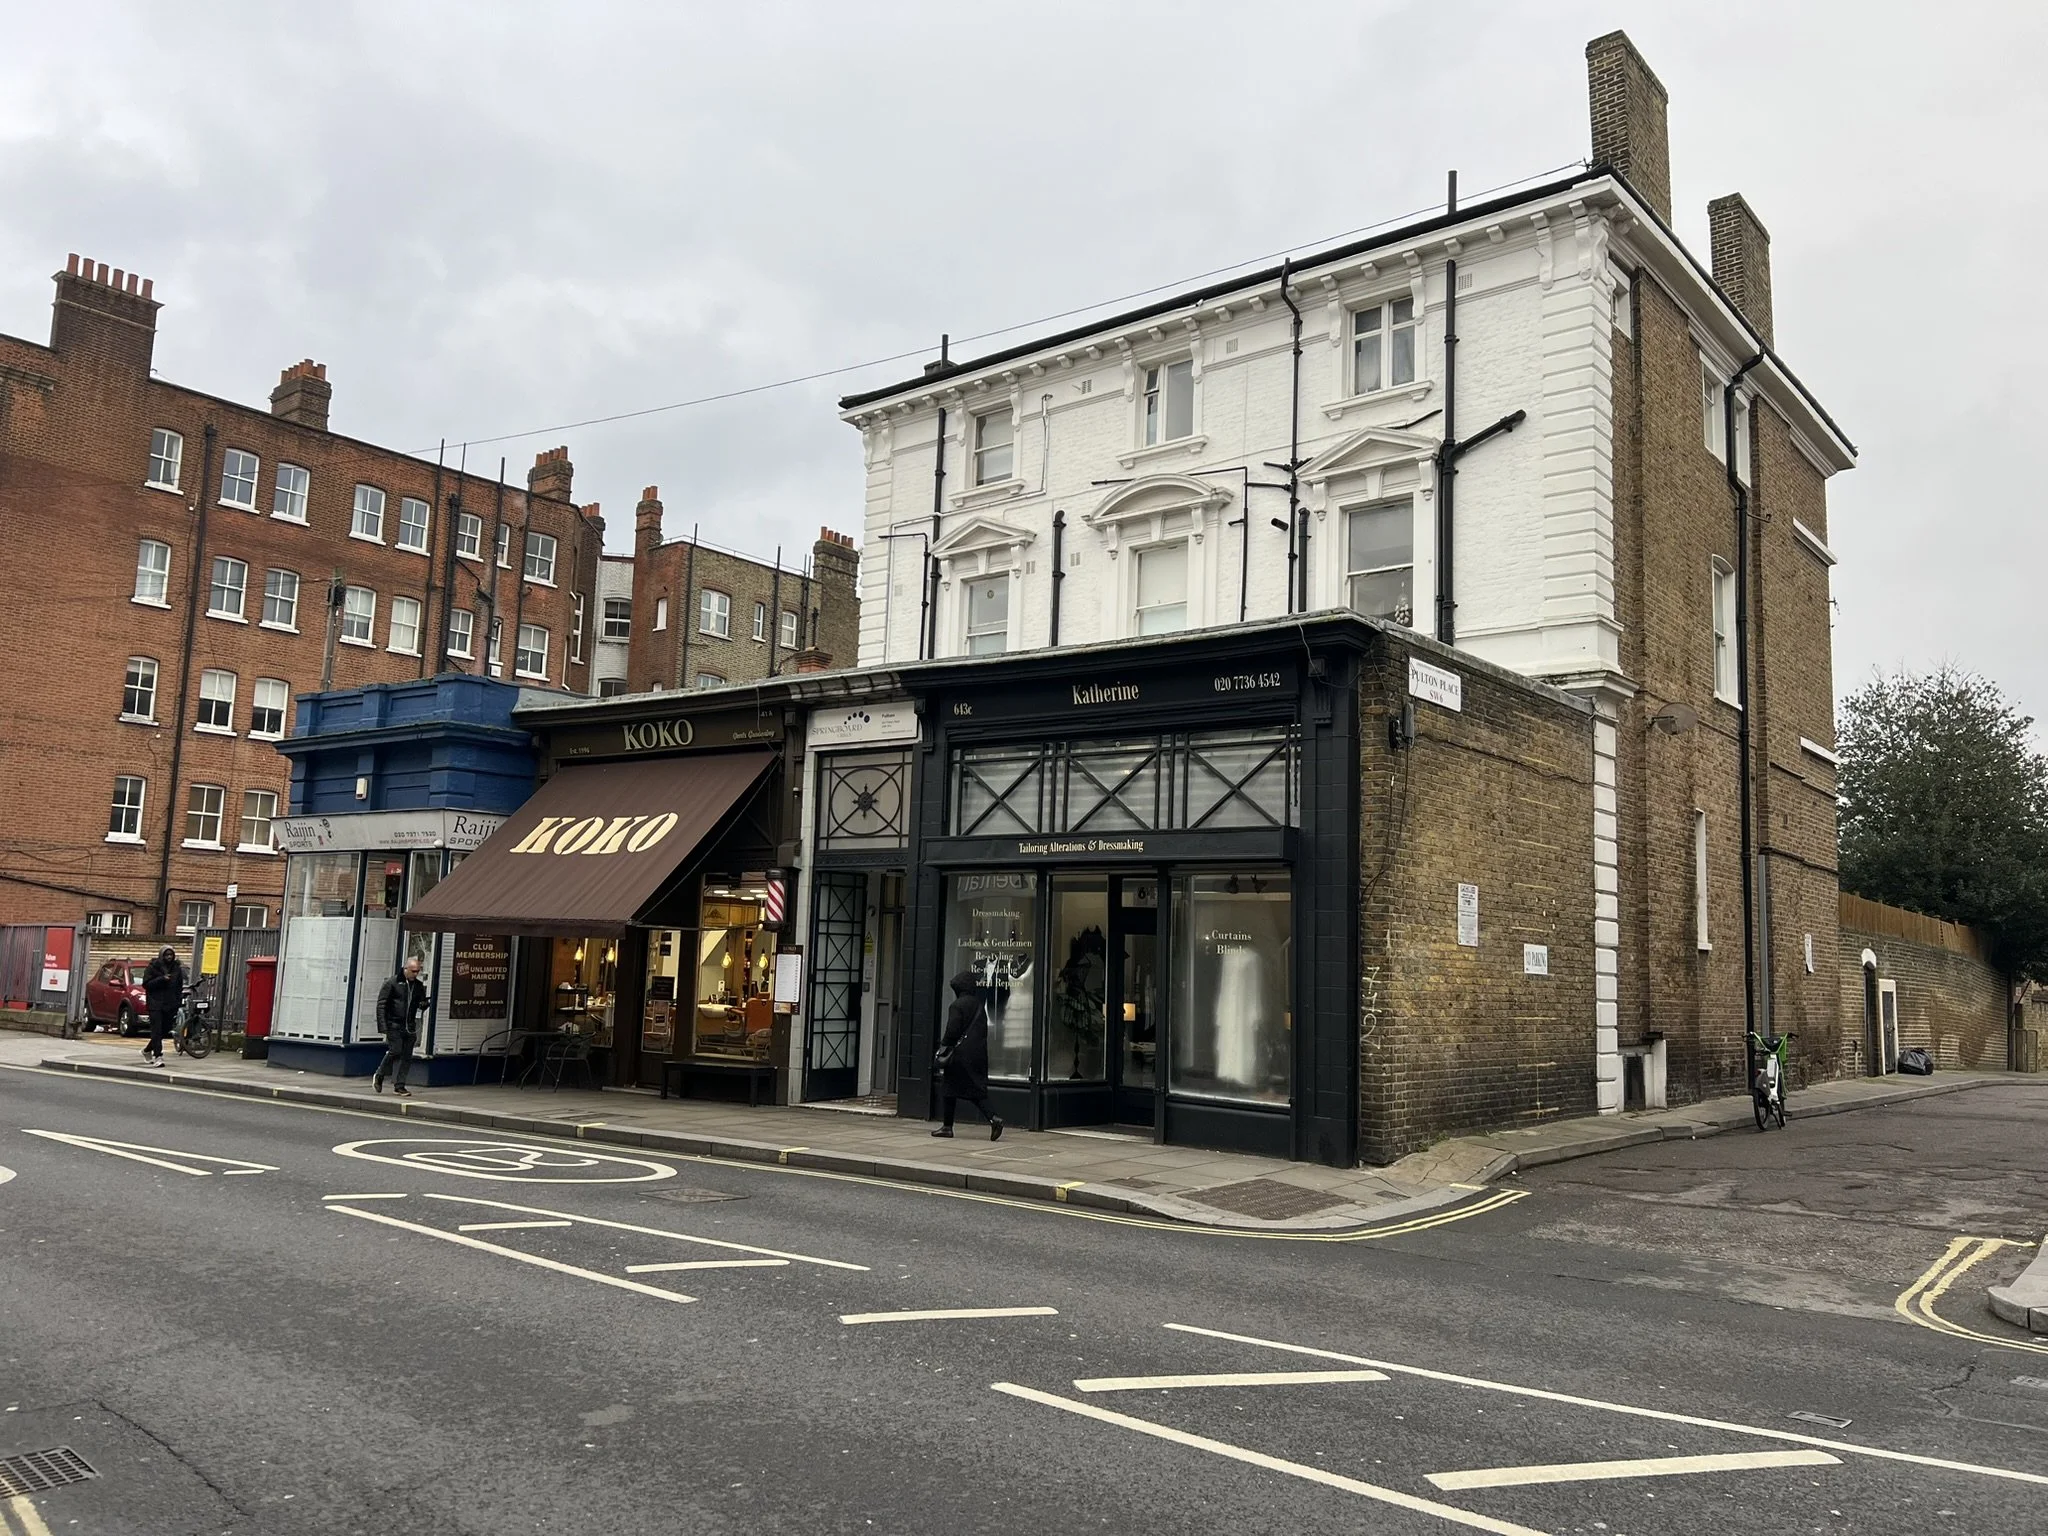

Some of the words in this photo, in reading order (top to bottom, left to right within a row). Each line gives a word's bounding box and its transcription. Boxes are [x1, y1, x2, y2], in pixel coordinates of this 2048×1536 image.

[1213, 676, 1231, 692] 020
[1233, 674, 1256, 691] 7736
[1257, 671, 1281, 688] 4542
[1411, 669, 1438, 687] PULTON
[1440, 679, 1459, 696] PLACE
[1072, 681, 1140, 706] Katherine
[1429, 689, 1444, 703] SW6
[953, 702, 973, 717] 643c
[622, 718, 694, 751] KOKO
[284, 821, 316, 841] Raijin
[453, 815, 497, 840] Raiji
[509, 812, 679, 856] KOKO
[289, 840, 313, 848] SPORTS
[449, 837, 481, 846] SPOR
[1019, 843, 1048, 855] Tailoring
[1049, 841, 1086, 853] Alterations
[1088, 840, 1097, 851] &
[1098, 839, 1144, 852] Dressmaking
[972, 908, 1021, 918] Dressmaking
[1212, 929, 1252, 941] Curtains
[472, 943, 494, 951] CLUB
[958, 939, 982, 948] Ladies
[983, 939, 990, 947] &
[991, 938, 1032, 947] Gentlemen
[456, 951, 509, 959] MEMBERSHIP
